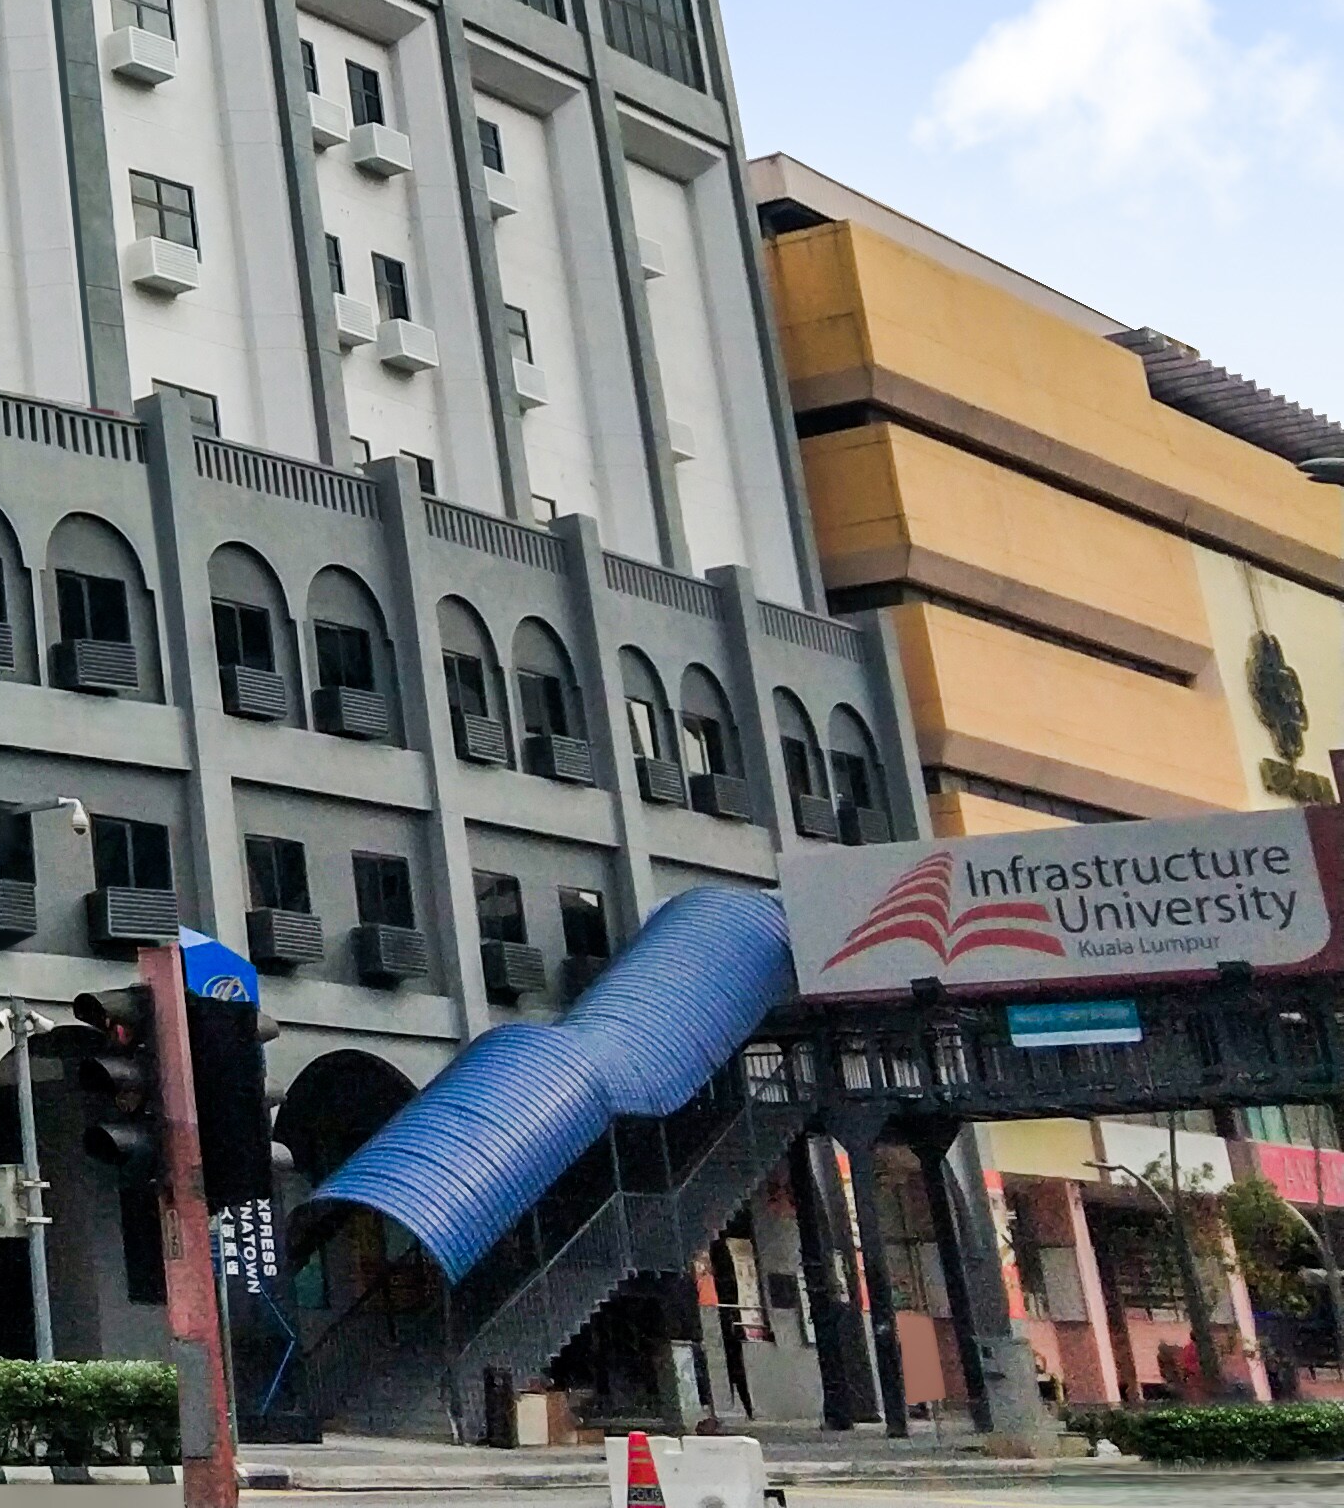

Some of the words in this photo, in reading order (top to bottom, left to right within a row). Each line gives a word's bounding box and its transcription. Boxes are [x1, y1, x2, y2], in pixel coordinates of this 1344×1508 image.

[965, 845, 1290, 897] Infrastructure
[1056, 883, 1297, 933] University
[1079, 938, 1134, 958] Kuala
[1140, 934, 1220, 955] Lumpur
[239, 1200, 261, 1294] NATOWN
[256, 1198, 278, 1277] XPRESS
